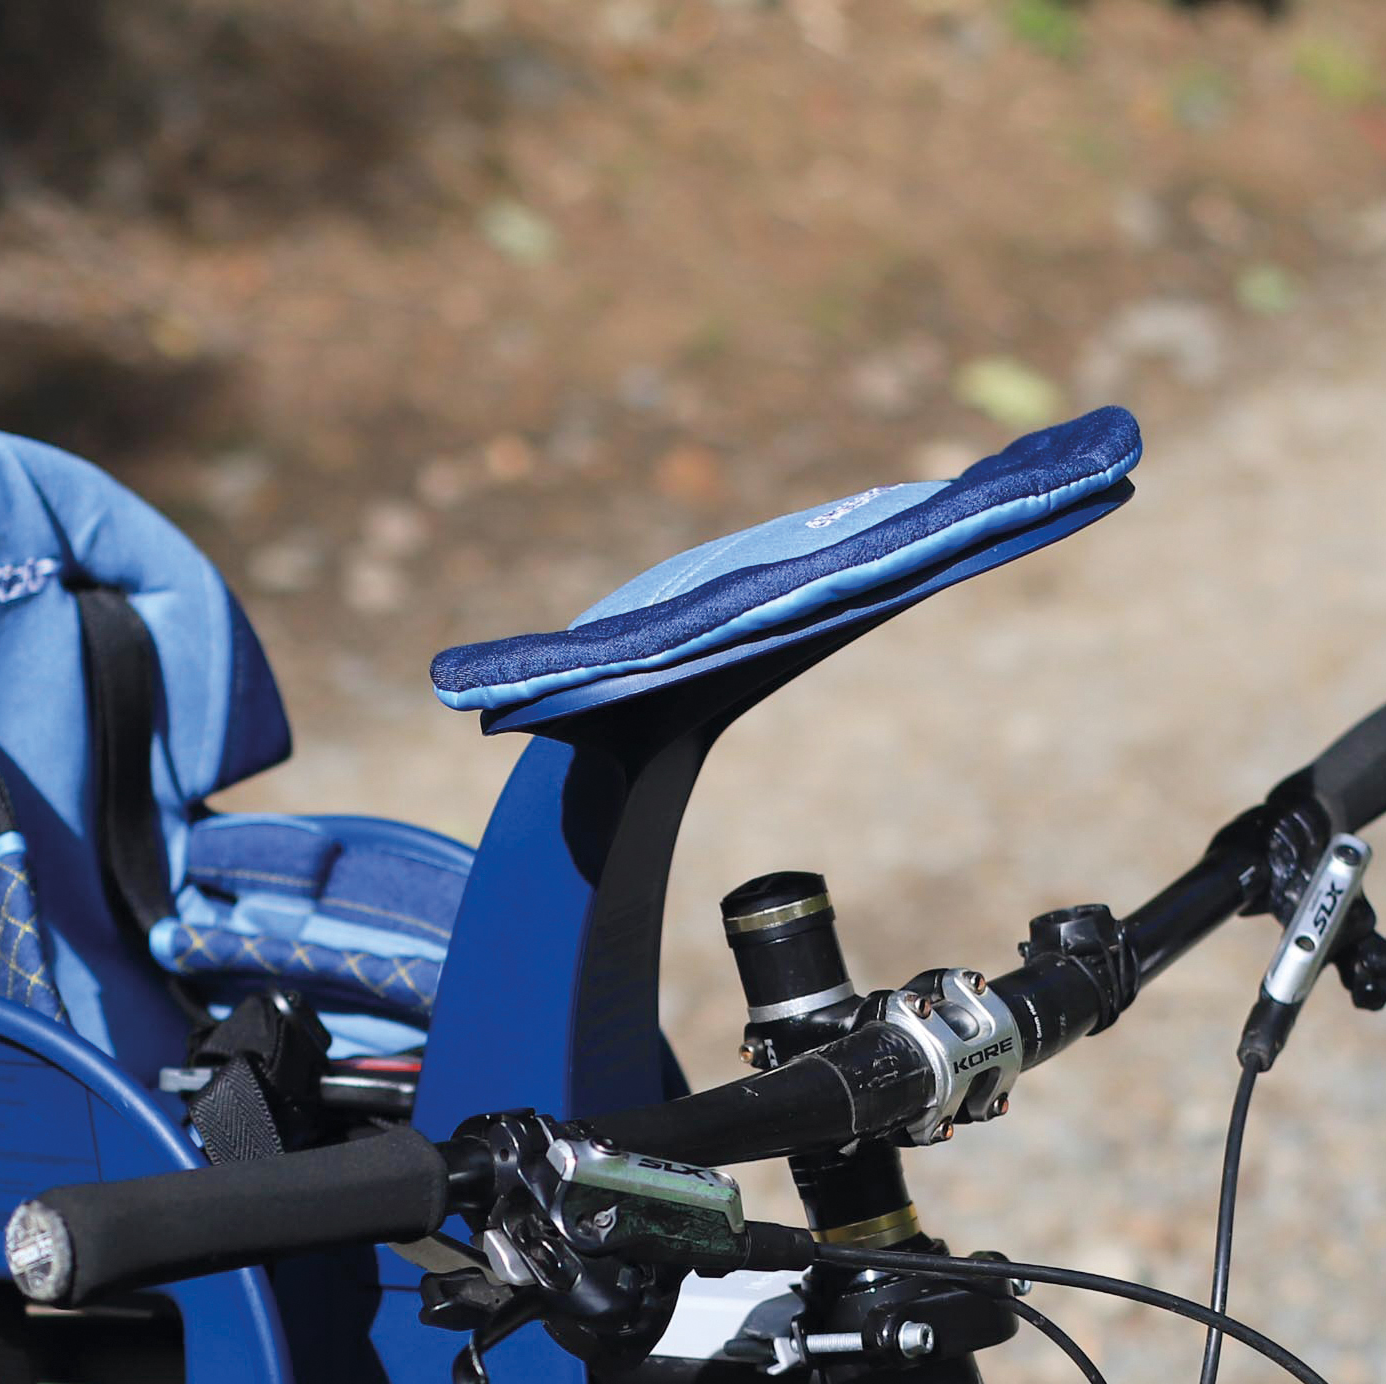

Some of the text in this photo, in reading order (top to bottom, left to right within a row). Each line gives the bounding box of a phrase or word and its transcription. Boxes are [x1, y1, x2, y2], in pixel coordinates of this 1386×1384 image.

[1313, 881, 1344, 936] SLX
[953, 1037, 1013, 1075] KORE
[638, 1158, 708, 1181] SLX
